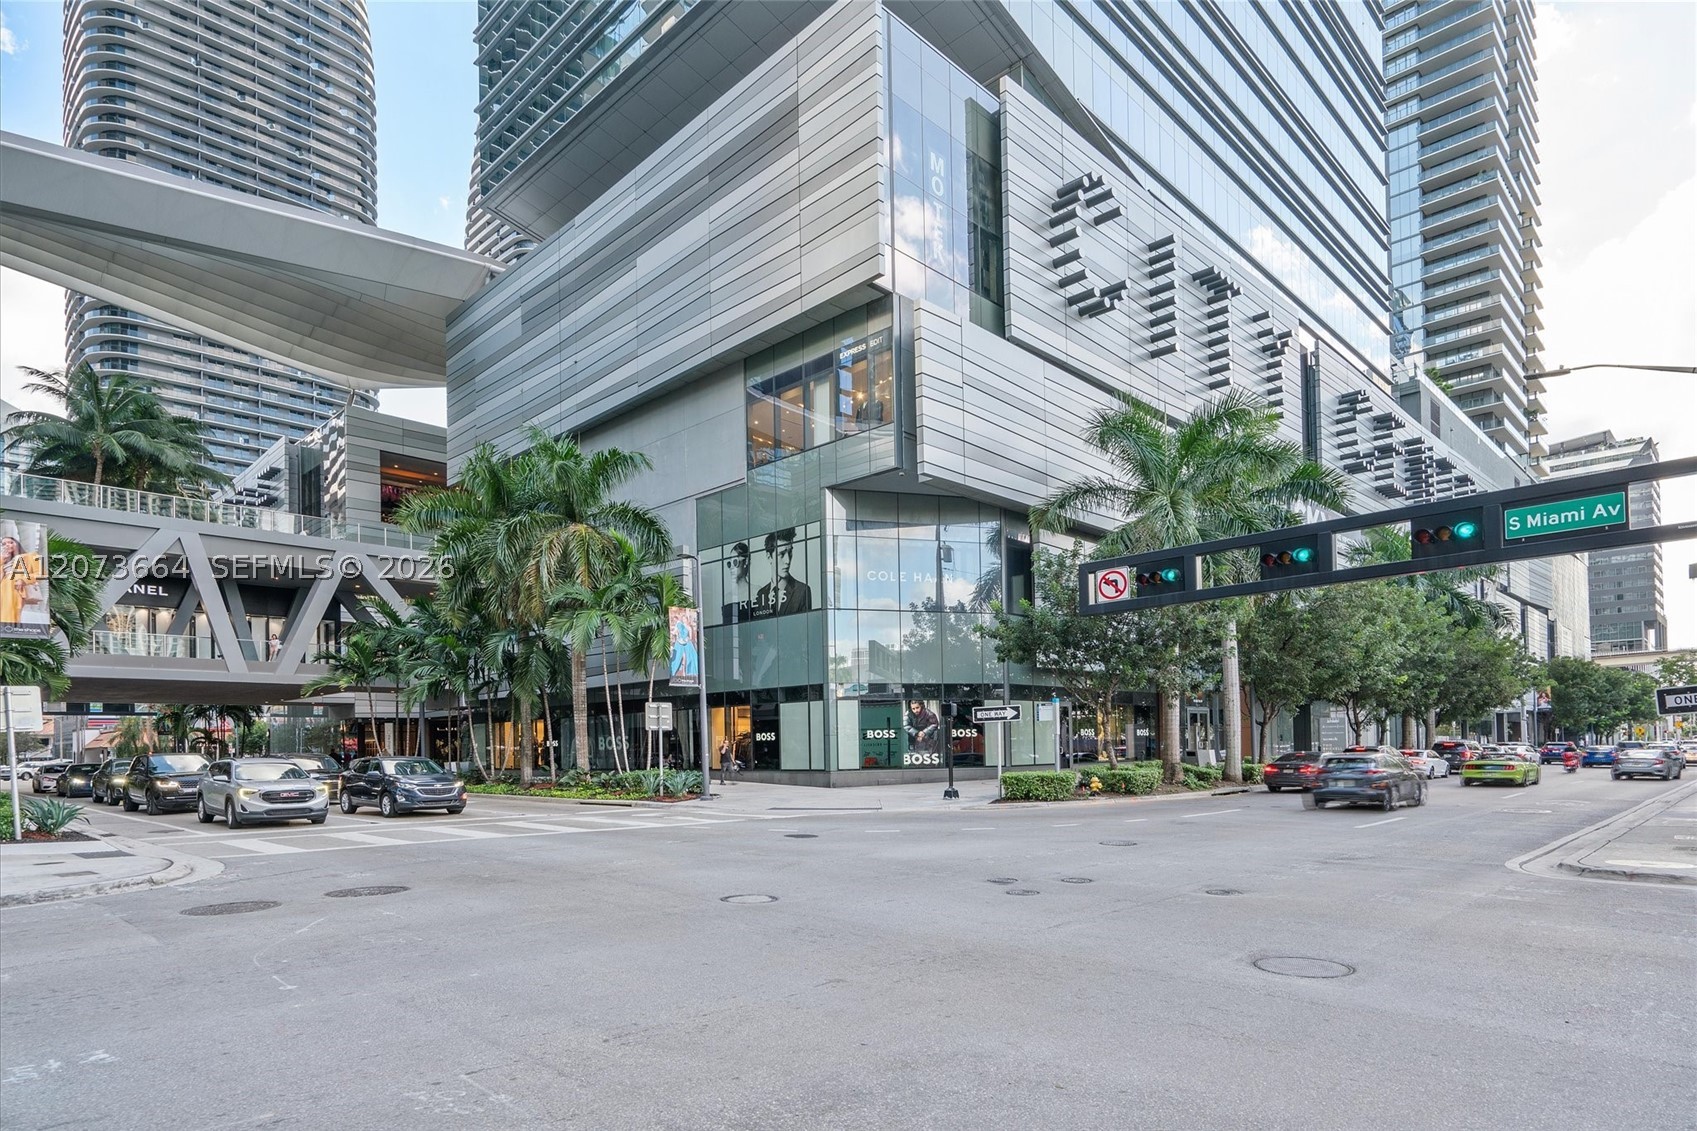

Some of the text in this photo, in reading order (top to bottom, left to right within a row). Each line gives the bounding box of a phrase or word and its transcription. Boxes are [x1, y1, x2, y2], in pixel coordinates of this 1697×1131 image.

[839, 336, 883, 360] EXPRESS EDIT
[1509, 503, 1621, 530] S Miami Av
[867, 571, 907, 582] COLE
[128, 584, 169, 597] NEL
[739, 589, 787, 610] REISS
[755, 732, 776, 741] BOSS
[866, 729, 896, 738] BOSS
[952, 729, 978, 738] BOSS
[1080, 728, 1095, 737] BOSS
[1136, 728, 1149, 737] BOSS
[546, 740, 559, 748] BSS
[903, 753, 940, 765] BOSS
